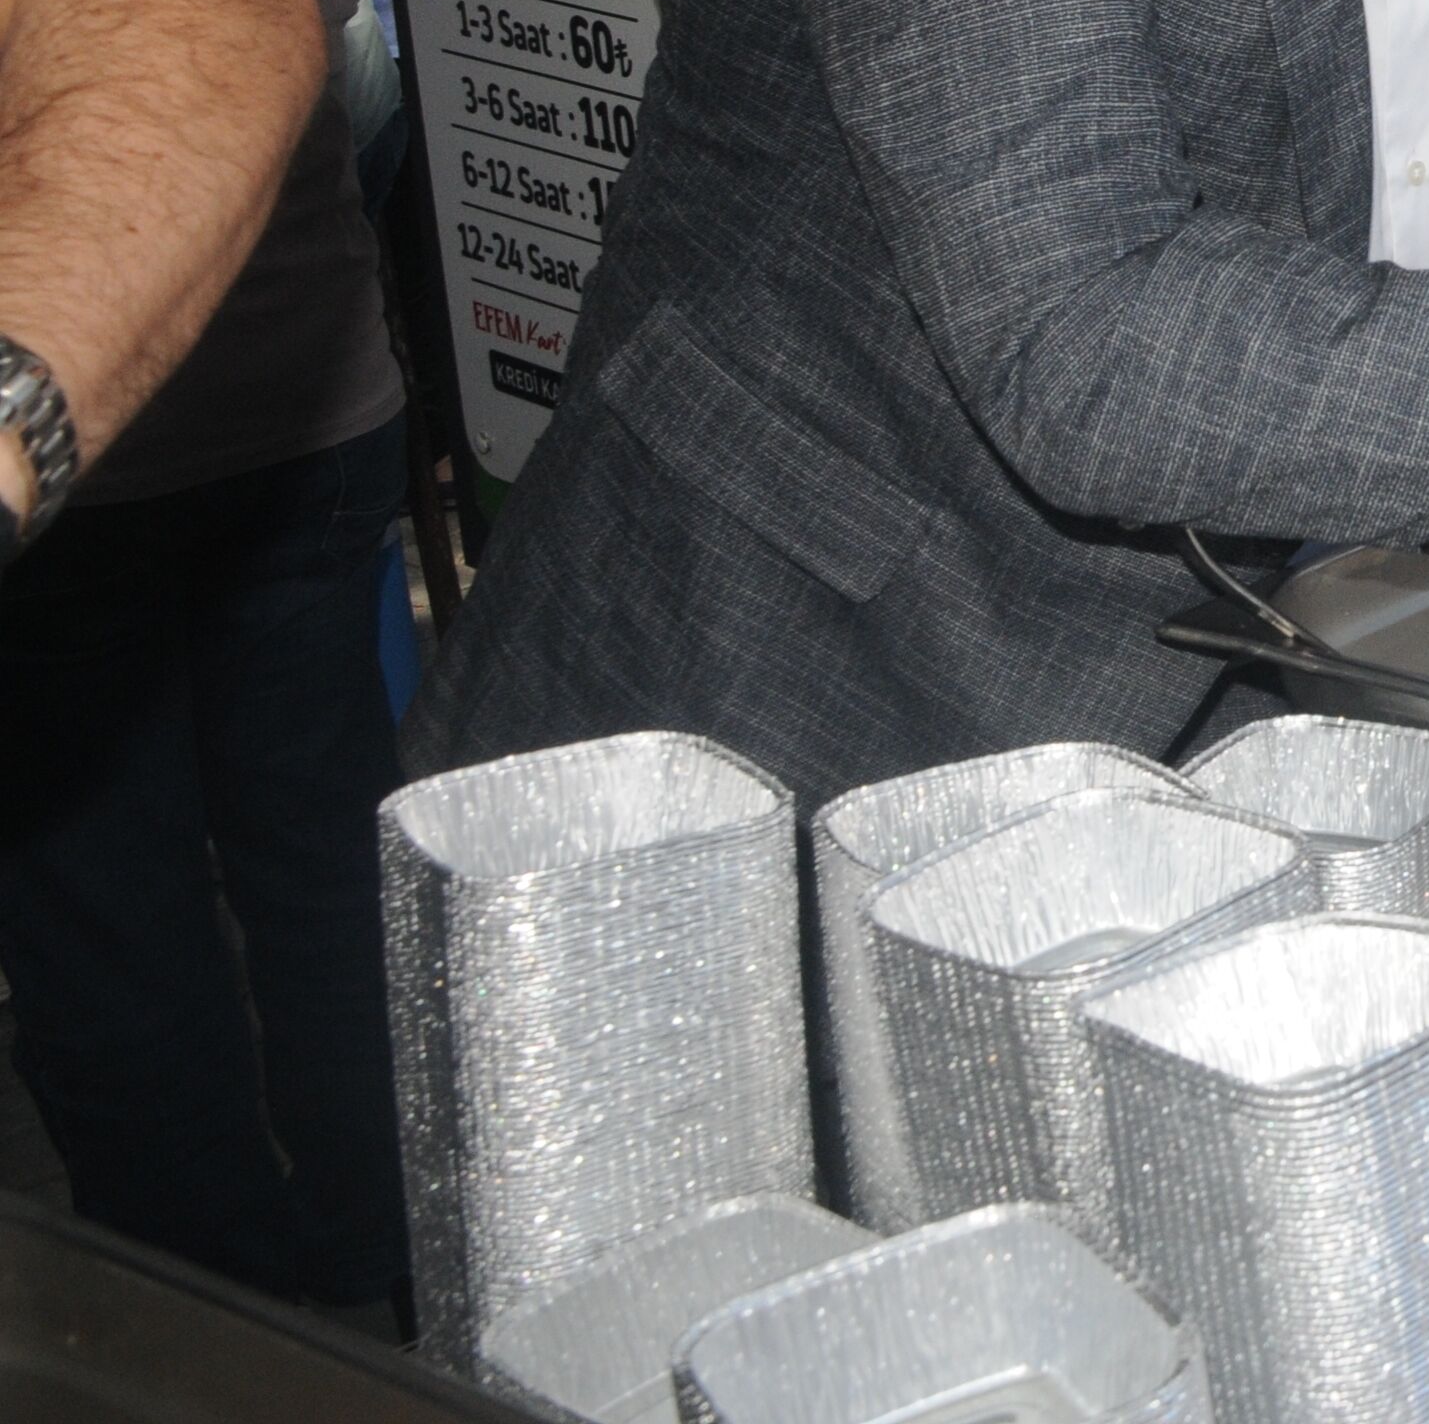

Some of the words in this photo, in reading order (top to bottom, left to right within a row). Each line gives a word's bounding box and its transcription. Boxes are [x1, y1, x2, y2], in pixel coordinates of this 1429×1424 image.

[456, 0, 494, 43] 1-3
[498, 9, 553, 58] Saat
[462, 76, 504, 121] 3-6
[508, 88, 563, 137] Saat
[462, 150, 515, 199] 6-12
[517, 166, 573, 216] Saat
[457, 222, 524, 275] 12-24
[527, 243, 582, 293] Saat
[473, 300, 524, 344] EFEM
[495, 361, 539, 396] KREDİ
